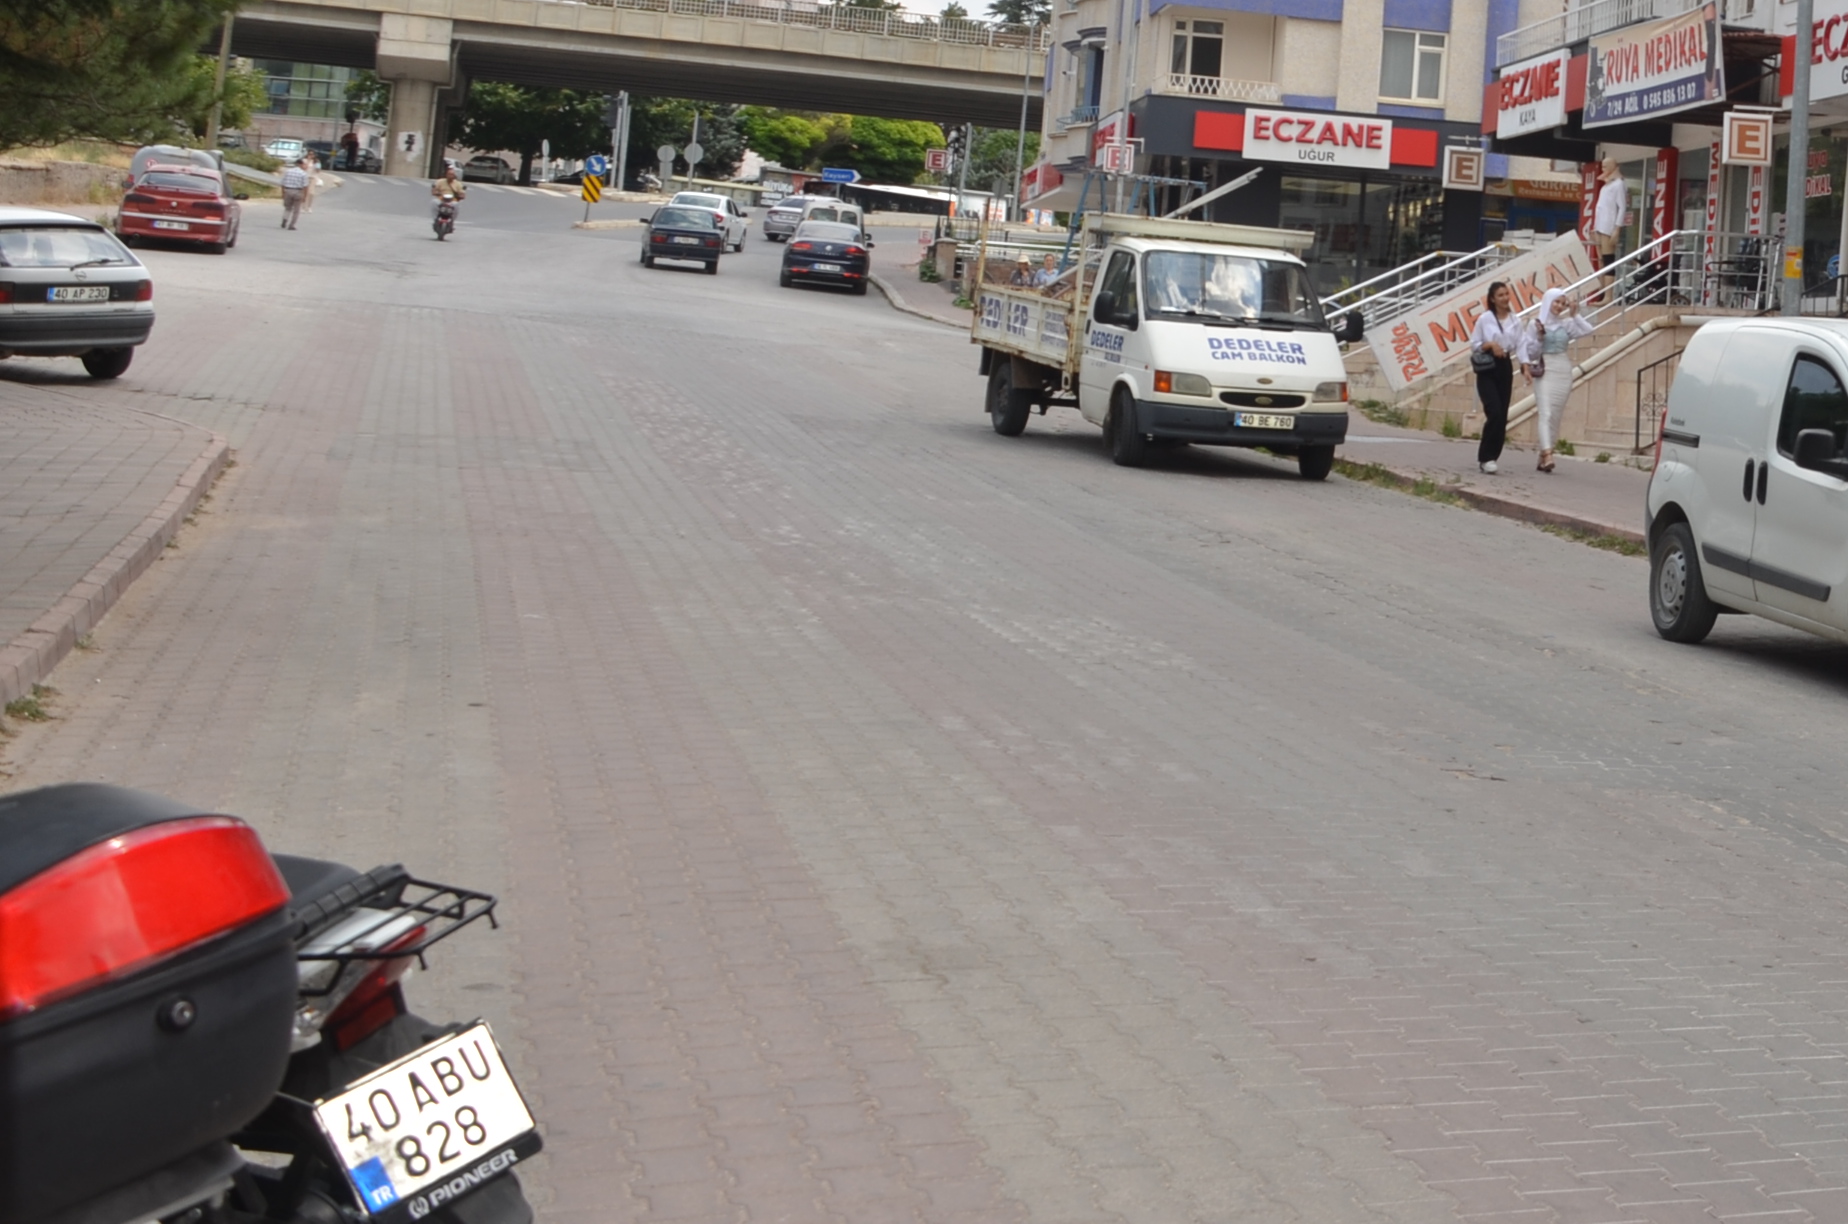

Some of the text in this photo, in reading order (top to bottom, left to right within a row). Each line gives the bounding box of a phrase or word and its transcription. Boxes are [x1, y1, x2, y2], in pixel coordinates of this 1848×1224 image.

[1605, 22, 1708, 87] RÜYA MEDİKAL
[1500, 57, 1562, 110] ECZANE
[1519, 108, 1536, 126] KAYA
[1253, 115, 1383, 149] ECZANE
[1738, 124, 1761, 156] E
[1298, 148, 1335, 163] UĞUR
[1457, 157, 1475, 181] E
[54, 287, 108, 299] 40 AP 230
[1090, 330, 1124, 352] DEDELER
[1207, 337, 1306, 356] DEDELER
[1211, 351, 1307, 366] CAM BALKON
[1241, 415, 1255, 425] 40
[344, 1039, 491, 1143] 40 ABU
[395, 1105, 487, 1178] 828
[428, 1147, 519, 1208] PIONEER
[370, 1184, 395, 1206] TR
